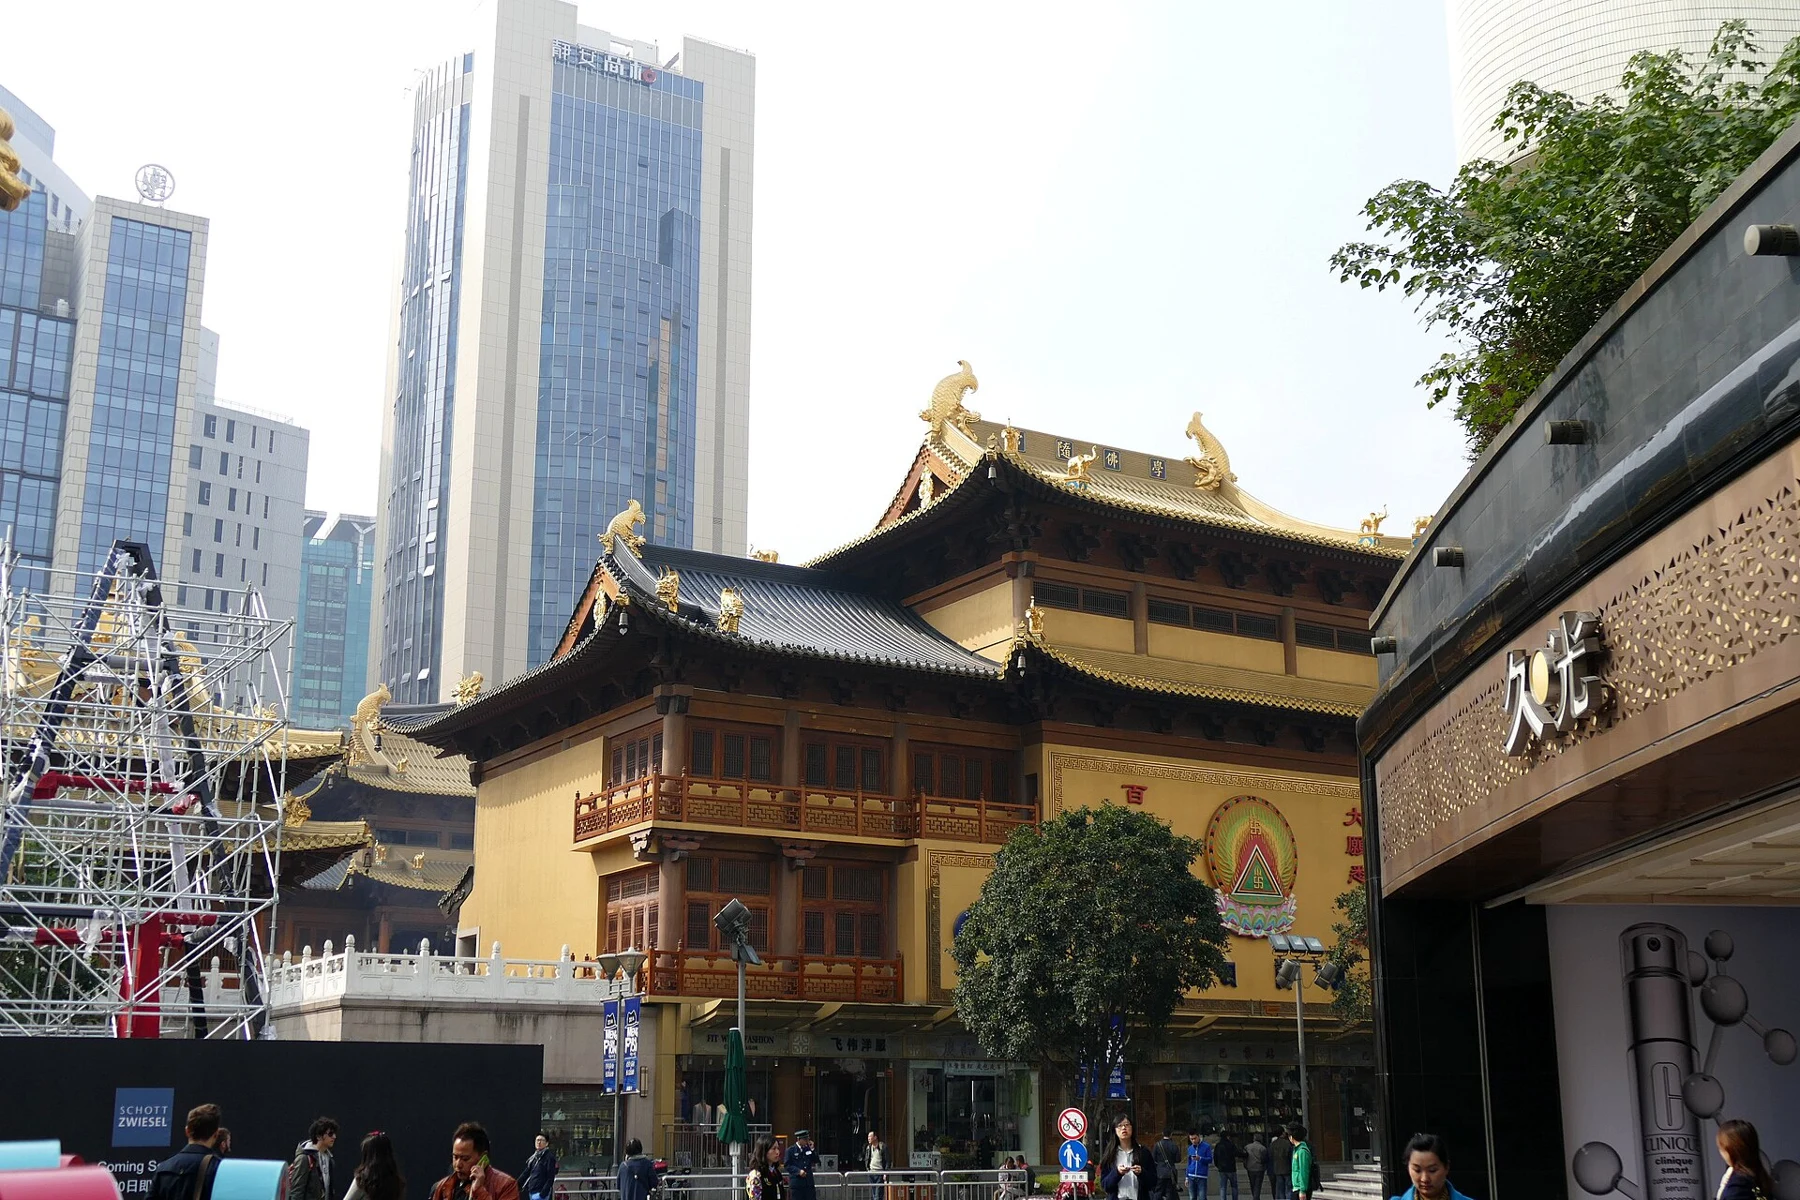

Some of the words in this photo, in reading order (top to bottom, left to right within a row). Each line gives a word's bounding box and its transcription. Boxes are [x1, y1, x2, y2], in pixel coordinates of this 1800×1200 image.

[1502, 610, 1602, 757] 久光
[119, 1105, 169, 1115] SCHOTT
[118, 1116, 168, 1128] ZWIESEL
[1655, 1156, 1694, 1166] clinique
[1660, 1167, 1690, 1175] smart
